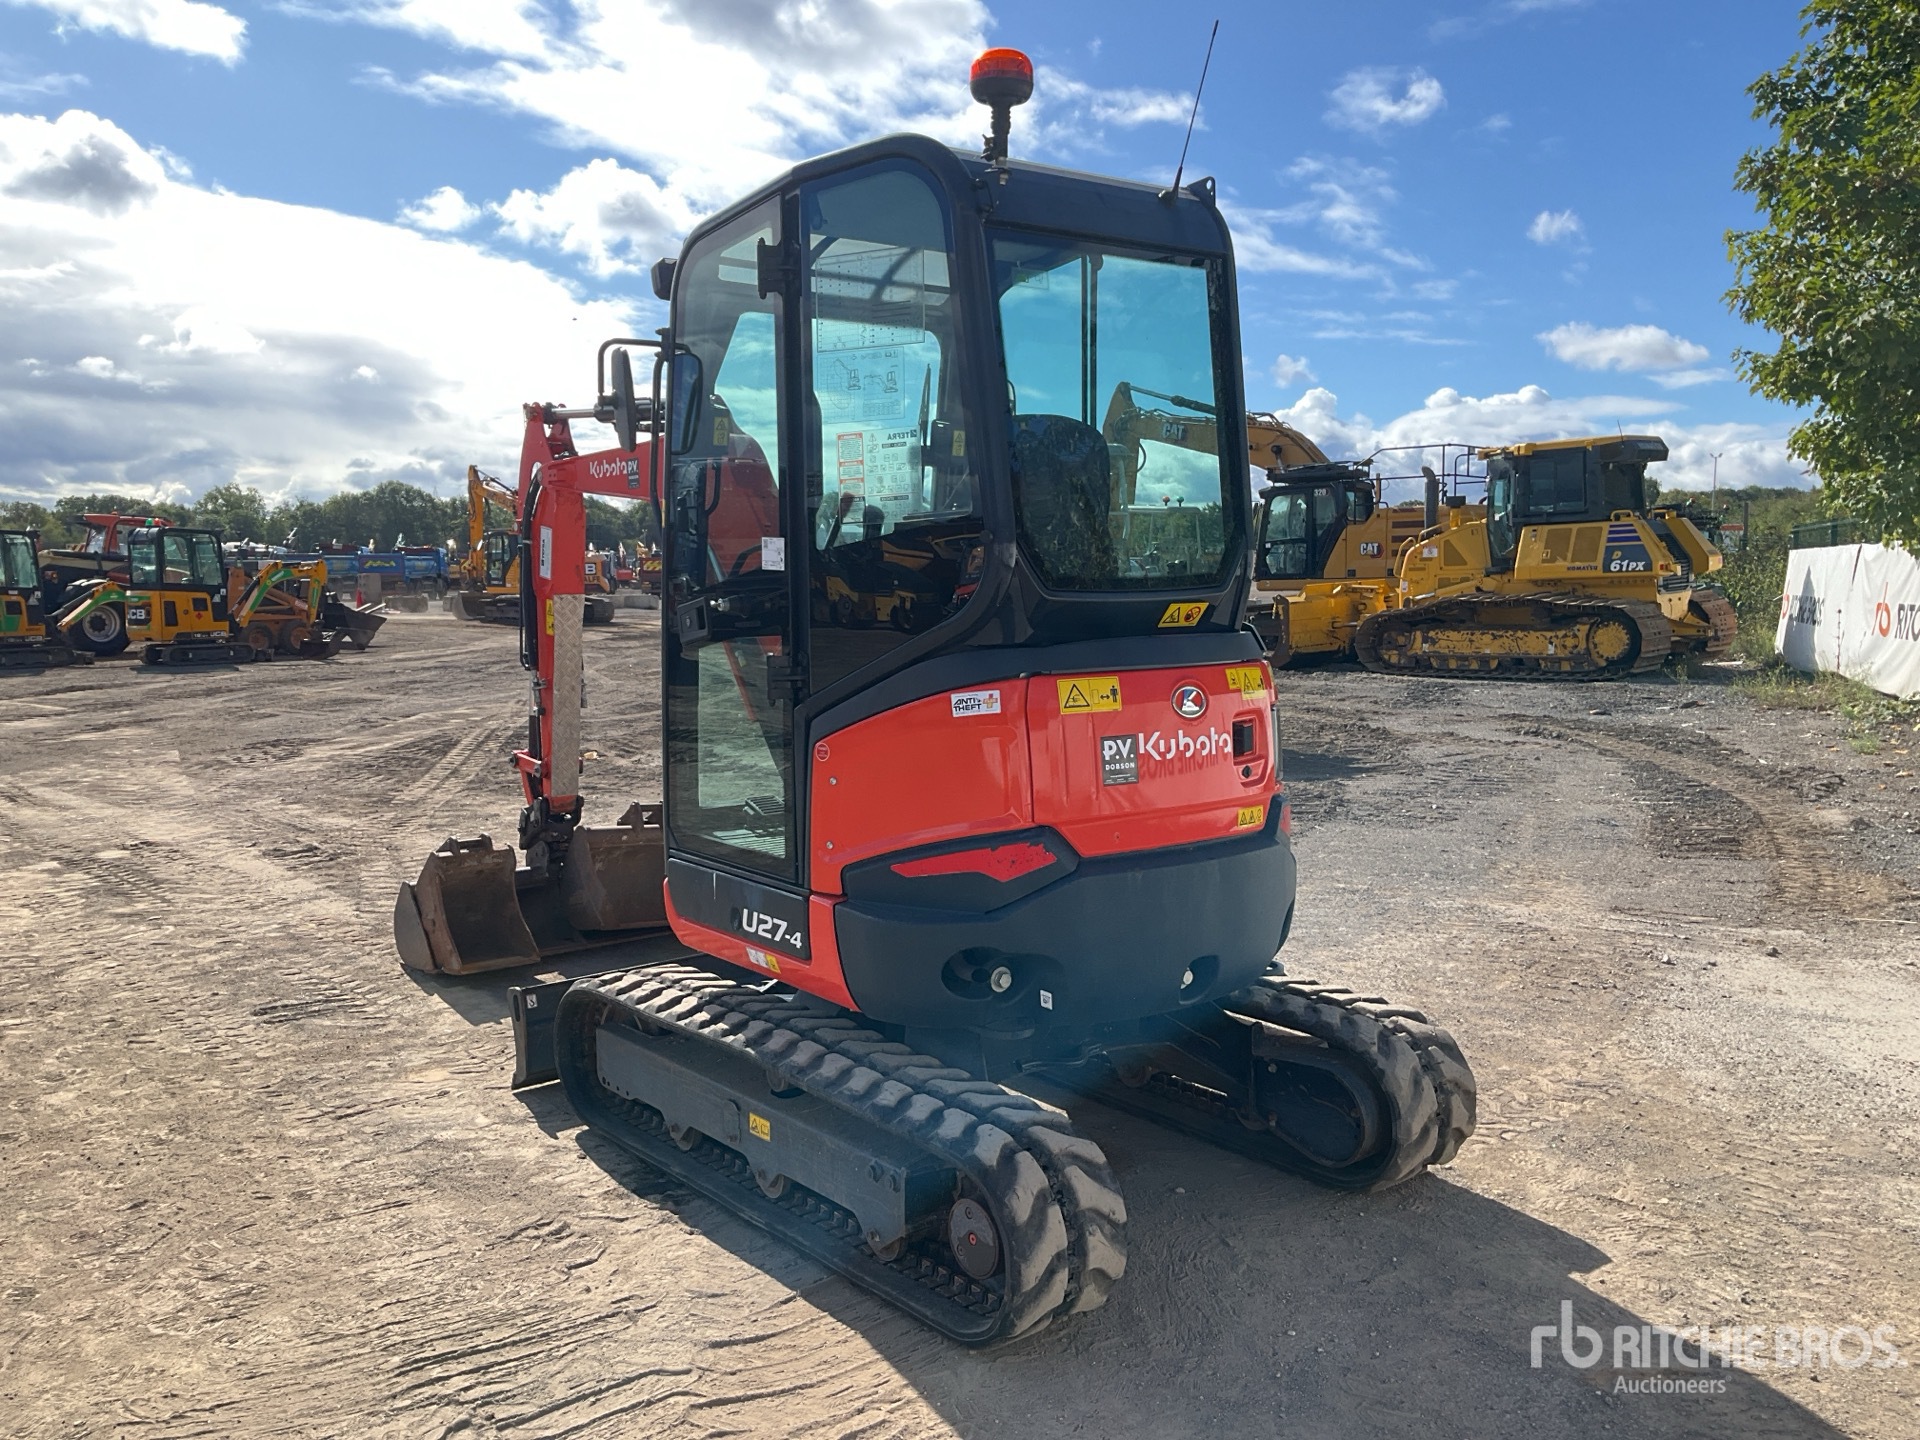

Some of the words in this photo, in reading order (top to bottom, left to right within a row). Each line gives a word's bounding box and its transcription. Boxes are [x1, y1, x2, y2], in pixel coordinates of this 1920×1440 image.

[1162, 423, 1184, 440] CAT
[590, 457, 627, 478] Kubota
[1361, 543, 1378, 555] CAT
[1612, 551, 1622, 559] D
[1610, 560, 1645, 571] 61PX
[954, 697, 976, 705] ANTI
[953, 703, 982, 712] THEFT
[1103, 738, 1134, 760] P.V.
[1138, 727, 1231, 760] Kubota
[1105, 762, 1135, 770] DOBSON
[742, 908, 803, 949] U27-4
